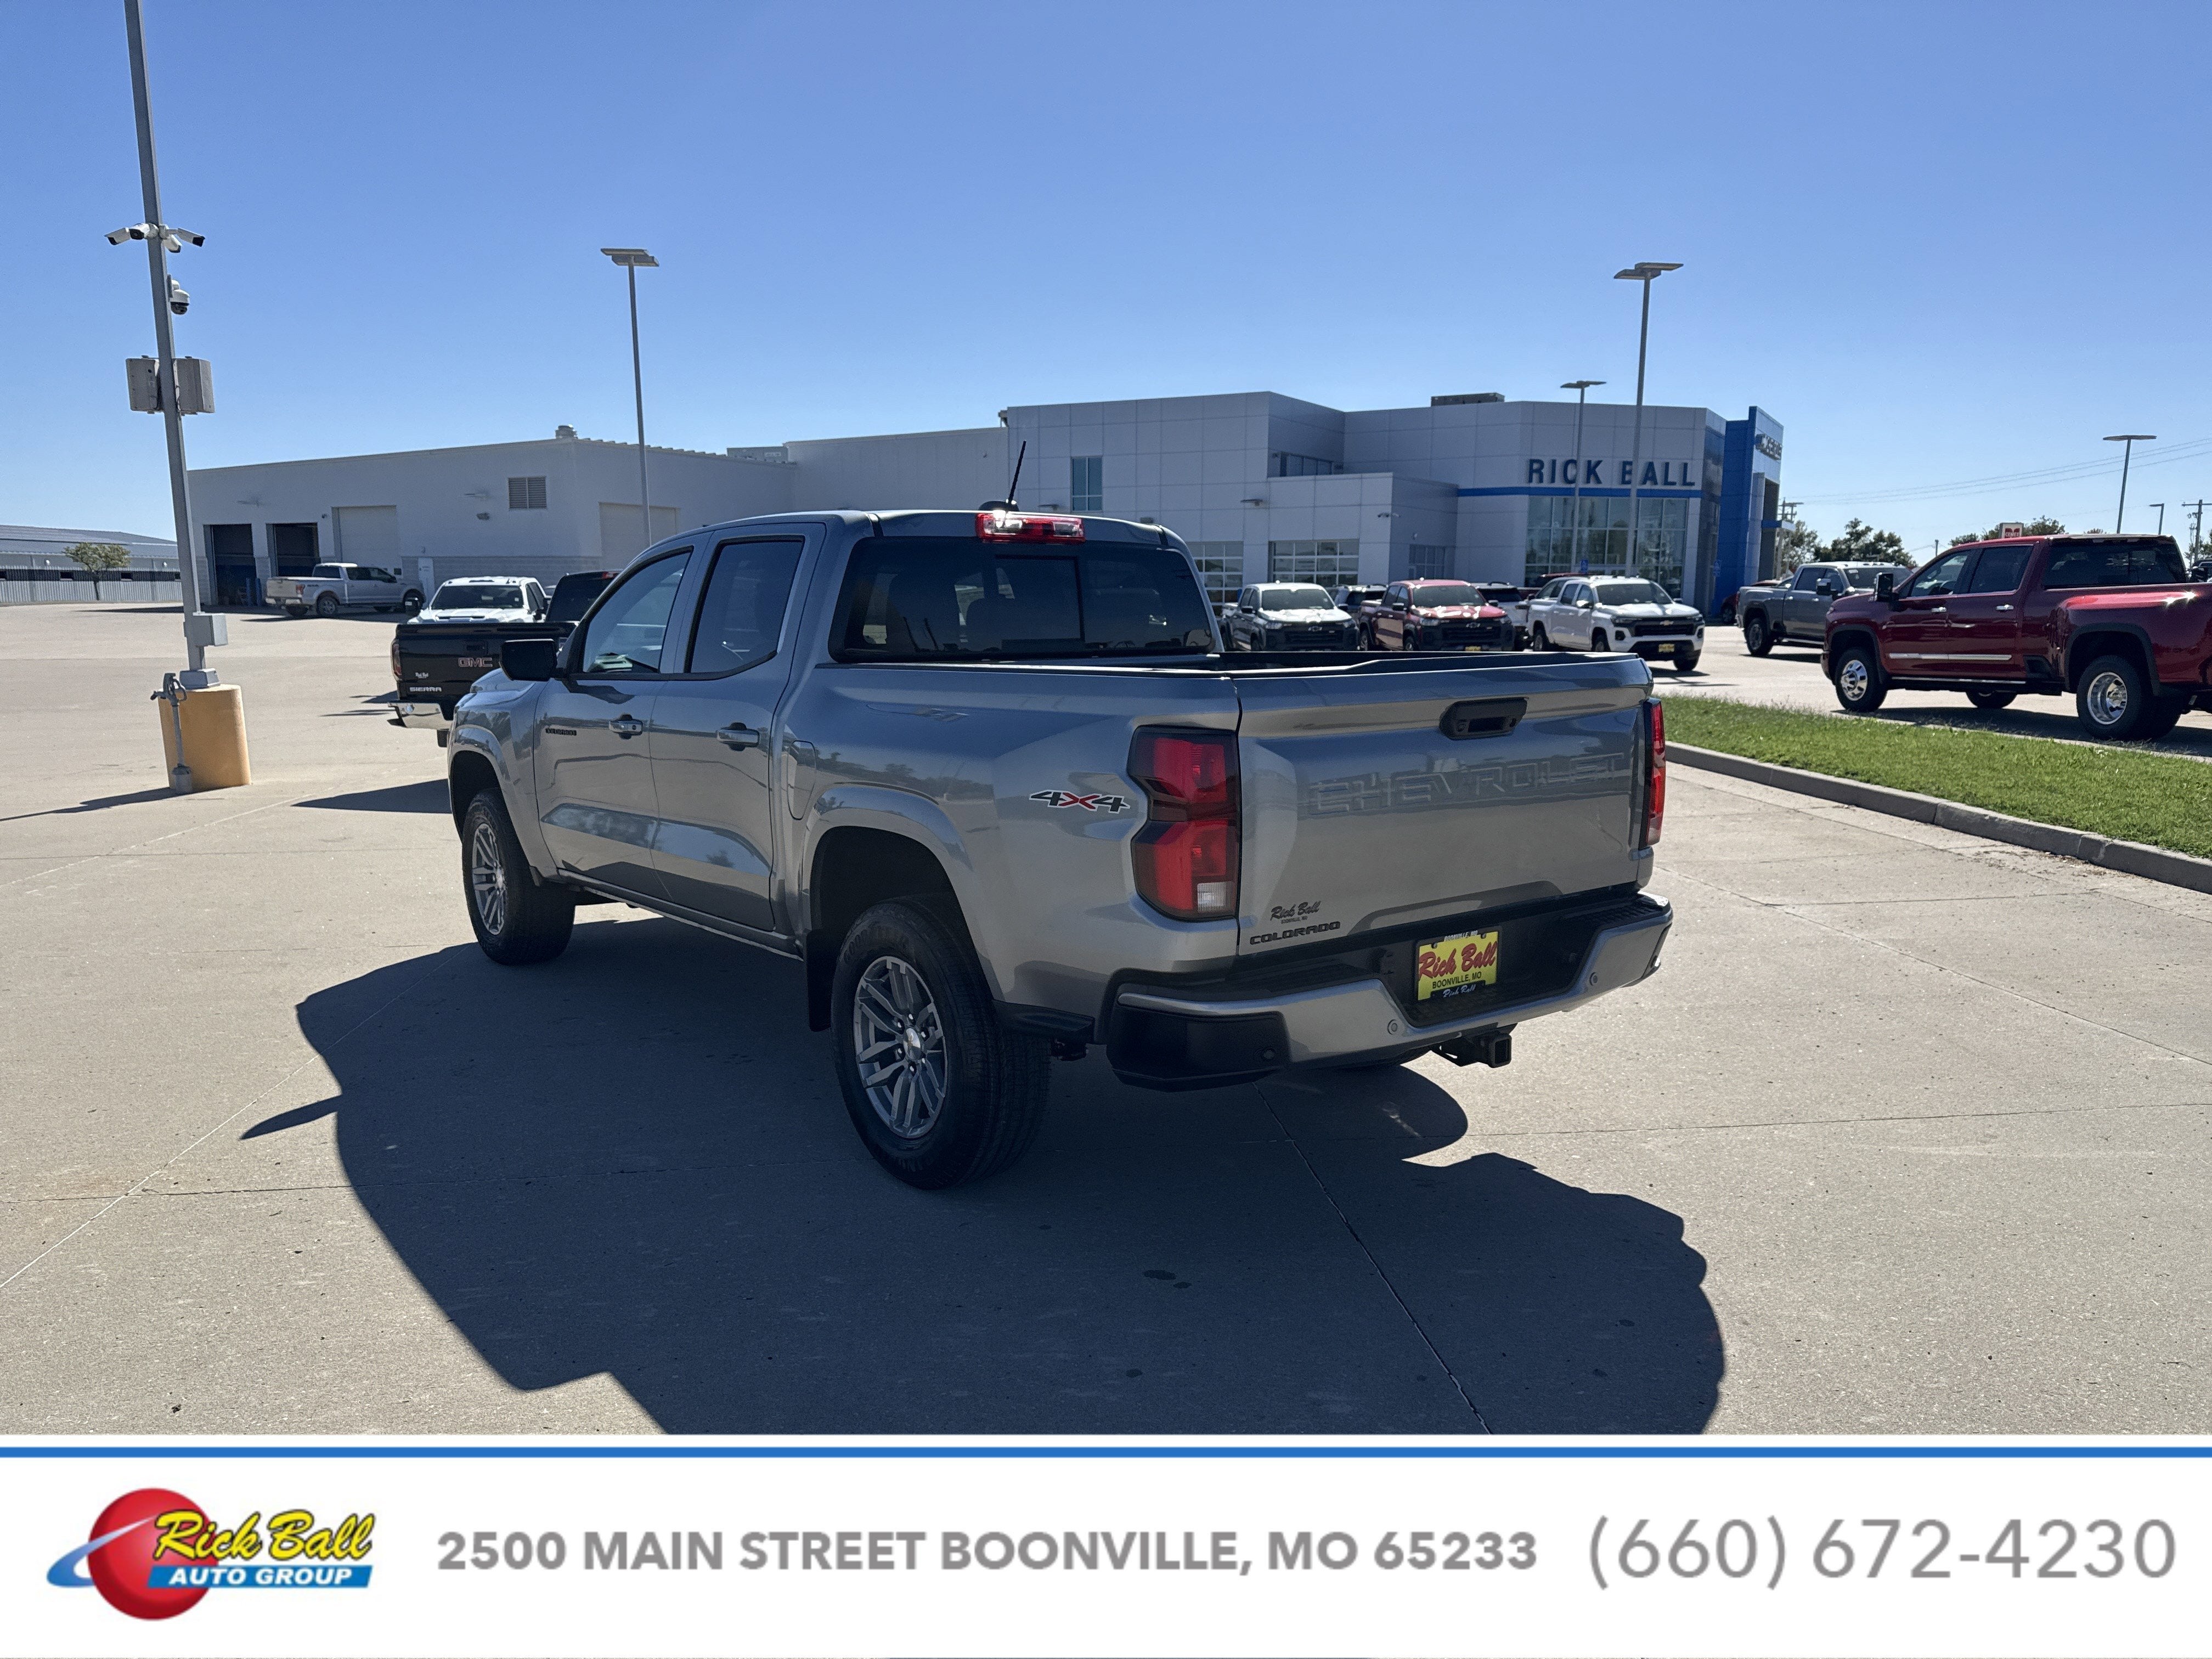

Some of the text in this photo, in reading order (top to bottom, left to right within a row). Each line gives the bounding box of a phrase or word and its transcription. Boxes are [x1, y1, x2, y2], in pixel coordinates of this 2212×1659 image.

[1528, 459, 1695, 487] RICK BALL
[458, 657, 493, 668] GMC
[1308, 752, 1624, 816] CHEVROLET
[1269, 900, 1322, 921] Rick Ball
[1250, 921, 1341, 945] COLORADO
[1419, 940, 1498, 981] Rick Ball
[1432, 971, 1482, 989] BOONVILLE, MO
